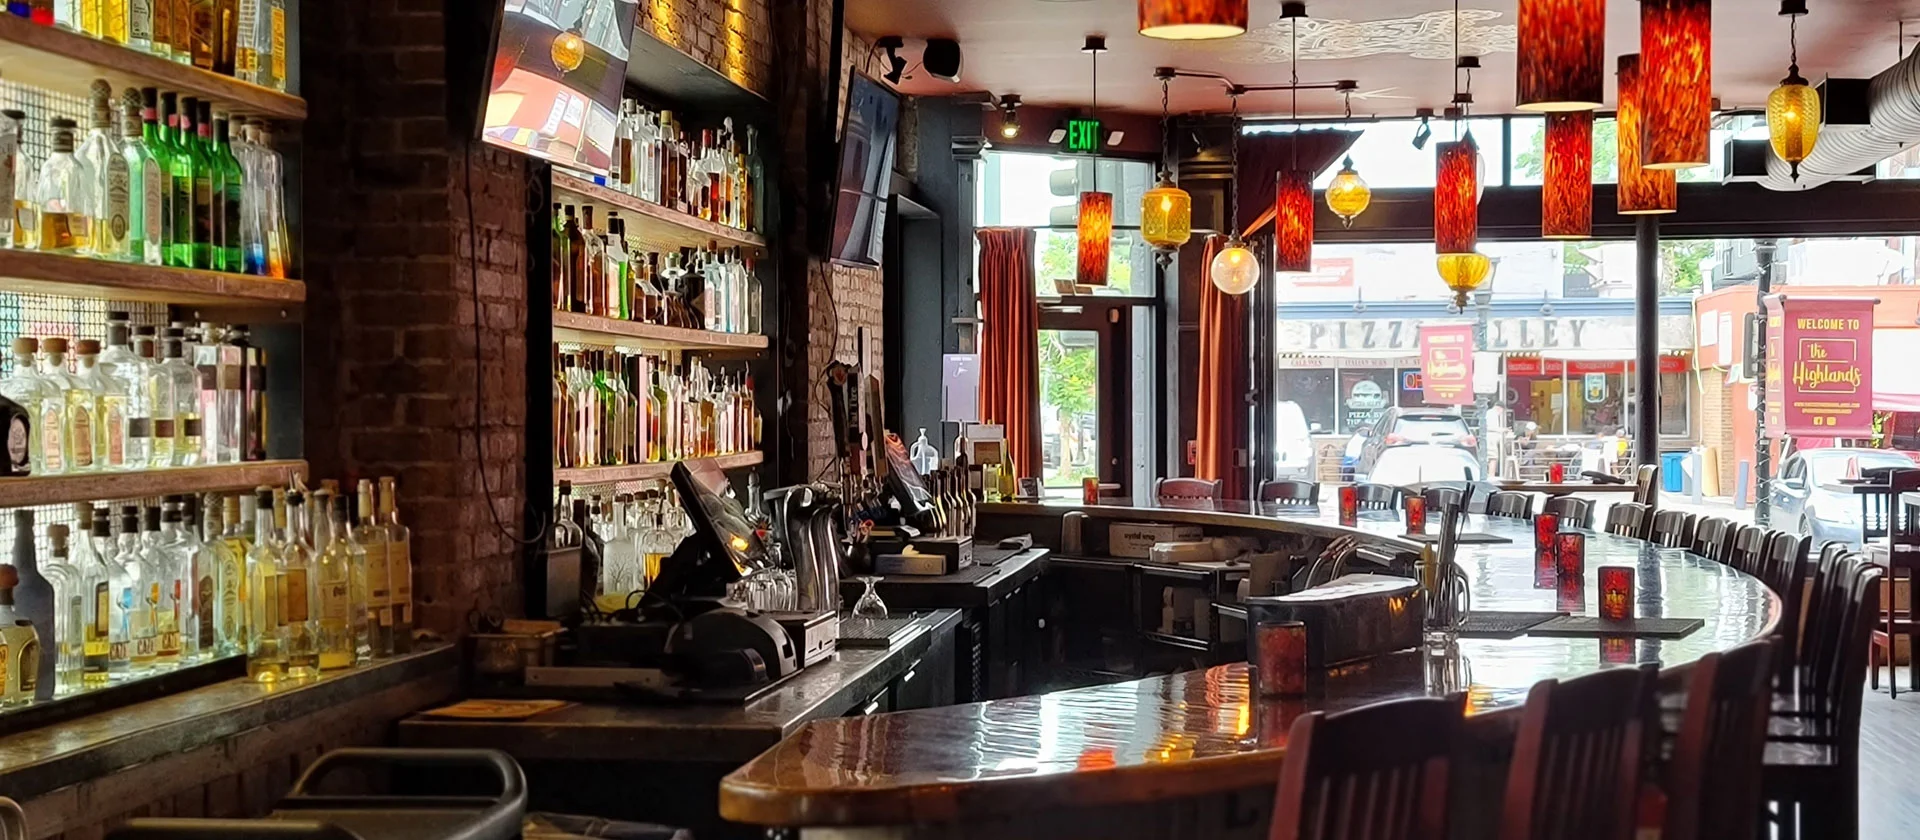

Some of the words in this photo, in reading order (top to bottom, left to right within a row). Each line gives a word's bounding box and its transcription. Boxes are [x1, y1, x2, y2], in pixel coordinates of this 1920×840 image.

[1068, 120, 1099, 150] EXIT
[1493, 319, 1587, 348] LLEY
[1797, 318, 1845, 330] WELCOME
[1847, 318, 1860, 330] TO
[1792, 361, 1862, 388] Highlands
